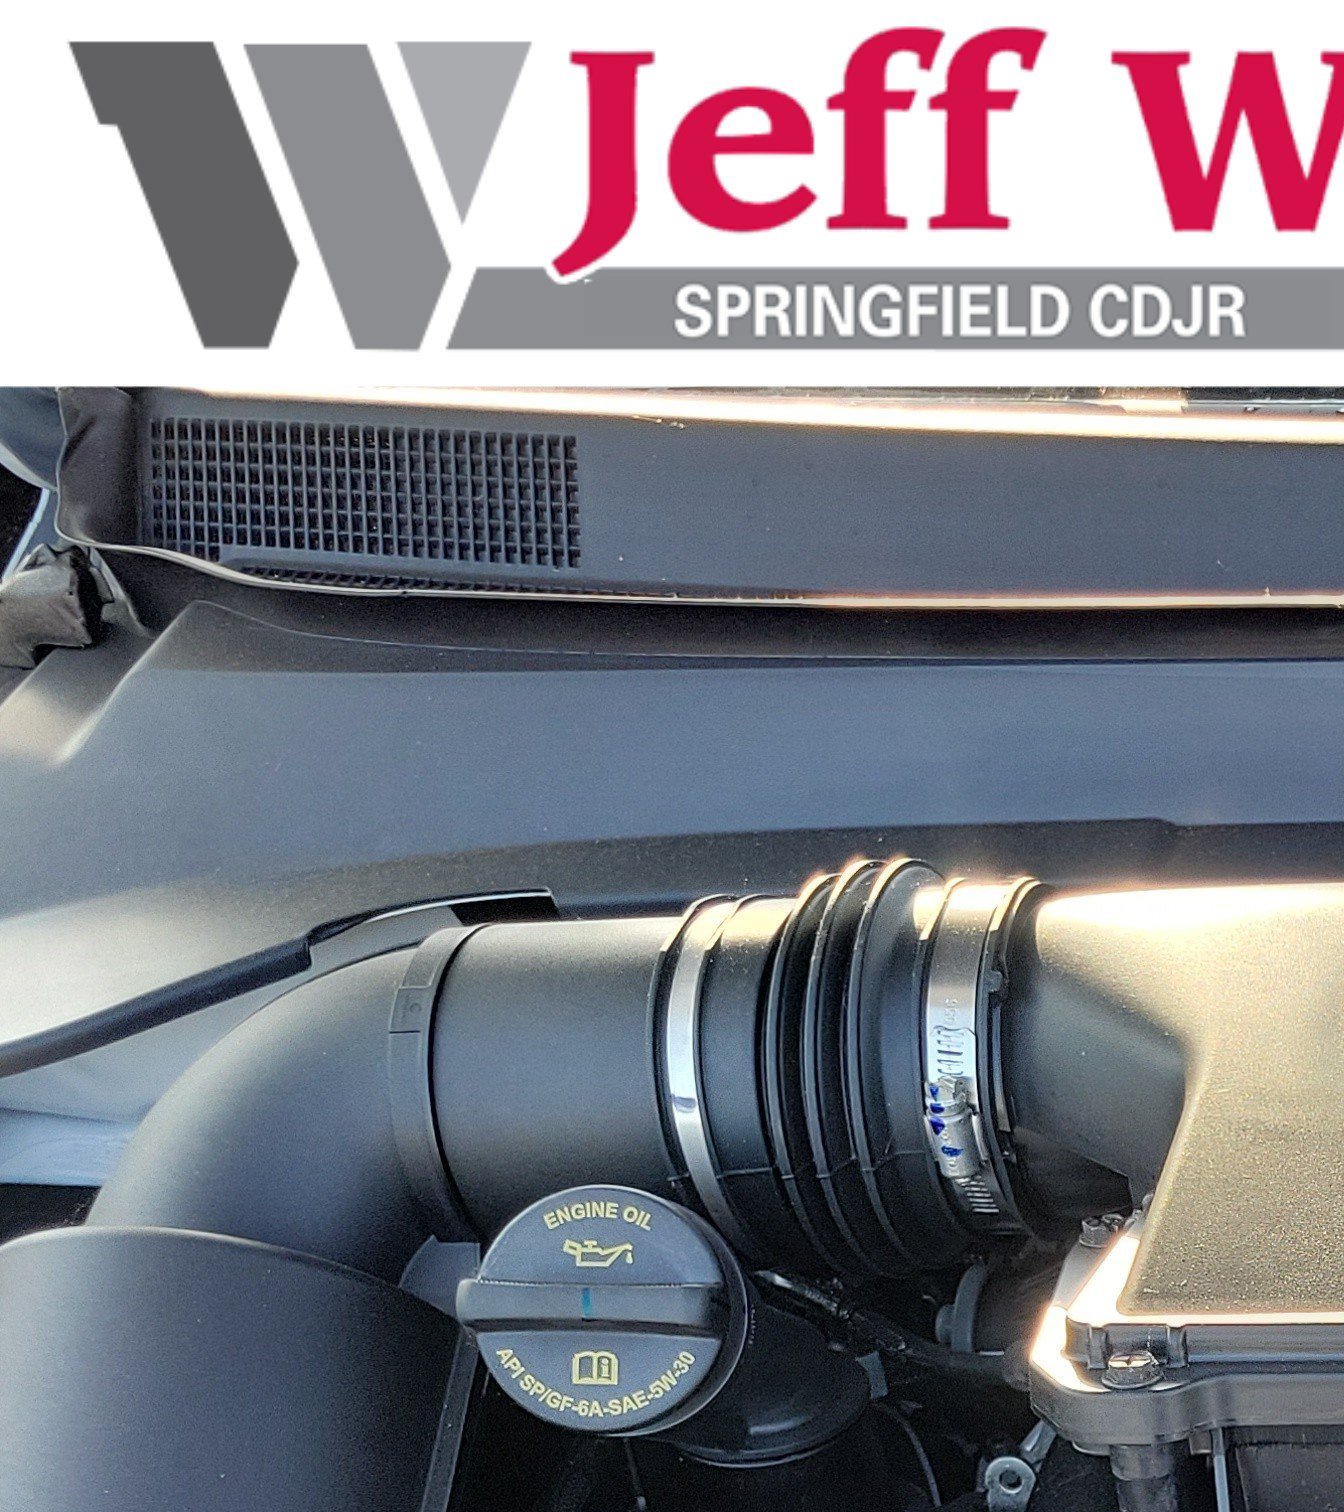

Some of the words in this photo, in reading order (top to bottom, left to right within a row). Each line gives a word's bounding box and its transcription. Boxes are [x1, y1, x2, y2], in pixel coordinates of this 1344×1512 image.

[543, 1201, 619, 1230] ENGINE
[622, 1206, 652, 1231] OIL
[497, 1350, 525, 1379] API
[519, 1351, 696, 1418] SP/GF-6A-SAE-5W-30
